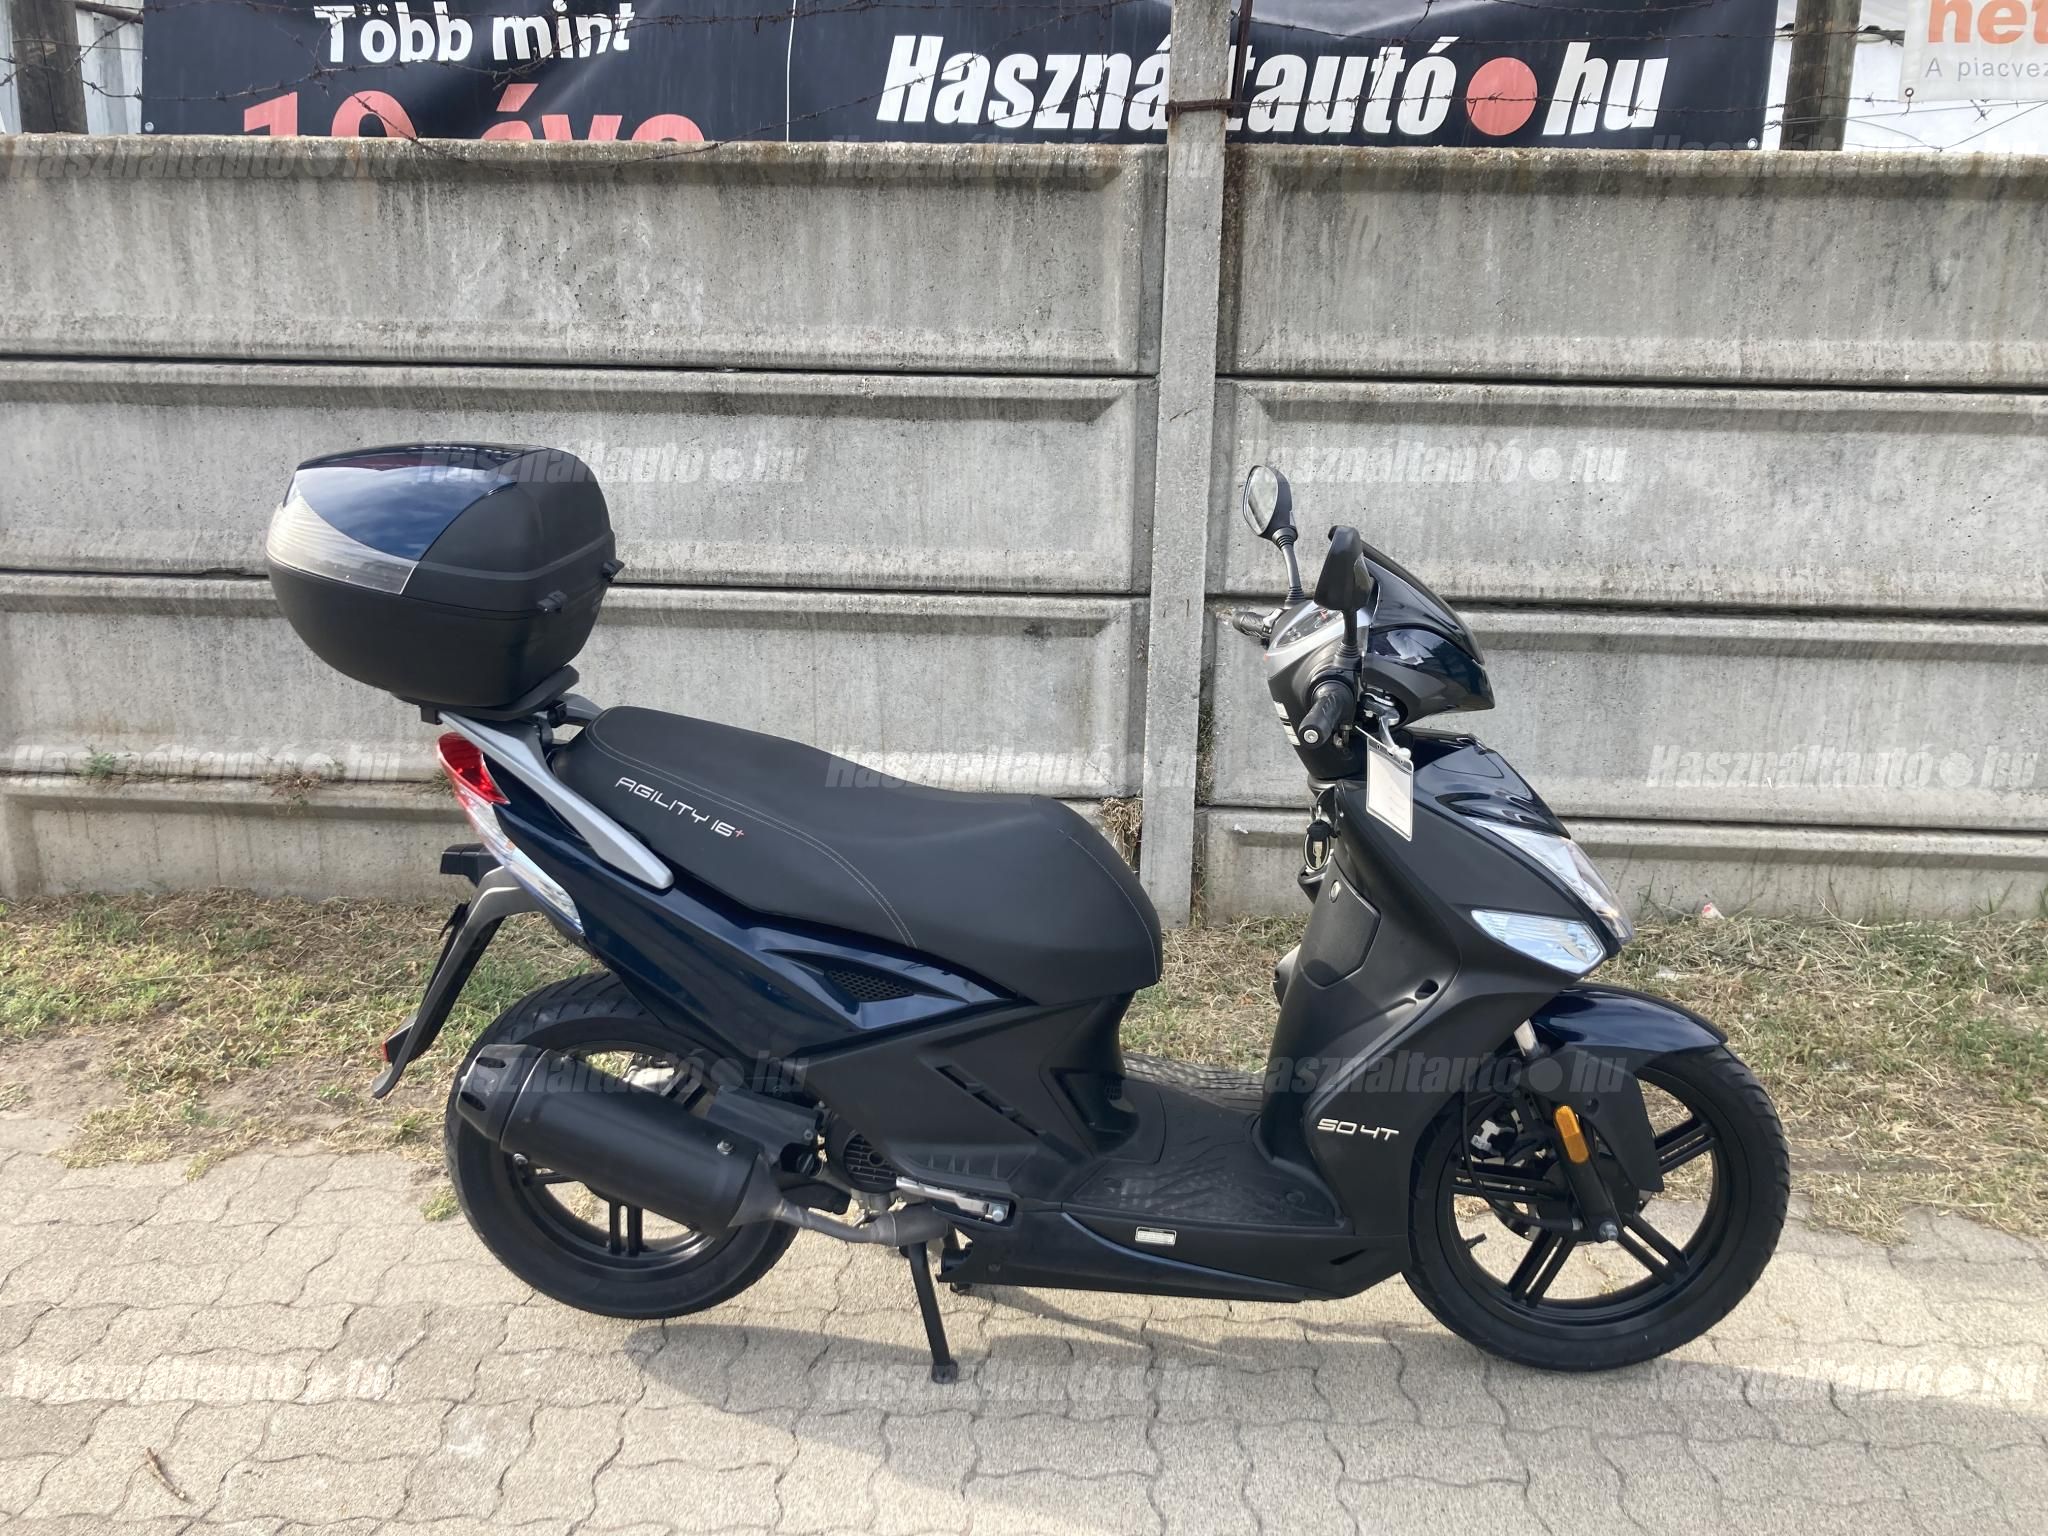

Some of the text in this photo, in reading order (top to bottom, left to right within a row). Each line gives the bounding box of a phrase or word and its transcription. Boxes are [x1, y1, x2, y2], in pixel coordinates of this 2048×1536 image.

[313, 0, 636, 63] Több mint
[1925, 57, 1943, 78] A
[614, 776, 710, 823] AGILITY
[1360, 1124, 1400, 1141] 4T
